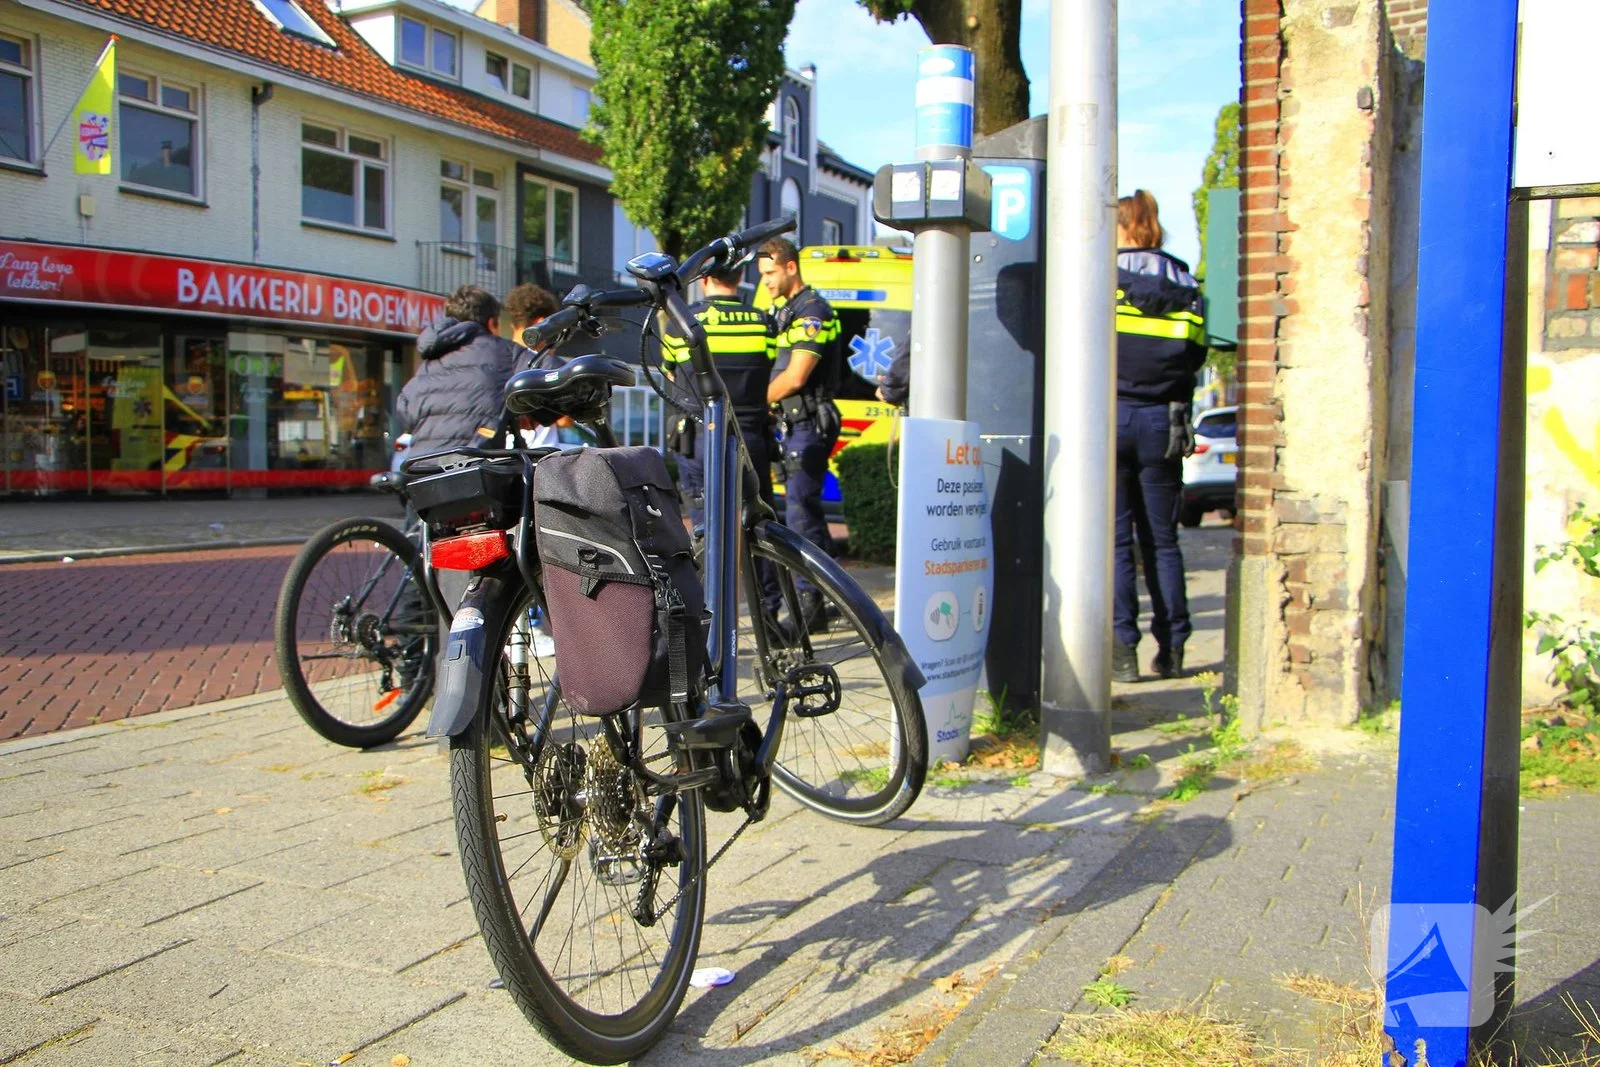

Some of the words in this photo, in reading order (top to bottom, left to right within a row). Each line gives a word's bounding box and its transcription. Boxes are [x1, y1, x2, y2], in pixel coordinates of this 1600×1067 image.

[999, 189, 1025, 232] P
[0, 252, 39, 276] Lang
[41, 256, 73, 275] leve
[7, 271, 64, 291] lekker!
[178, 269, 322, 316] BAKKERIJ
[946, 438, 970, 465] Let
[937, 478, 961, 493] Deze
[927, 503, 963, 516] worden
[931, 538, 962, 551] Gebruik
